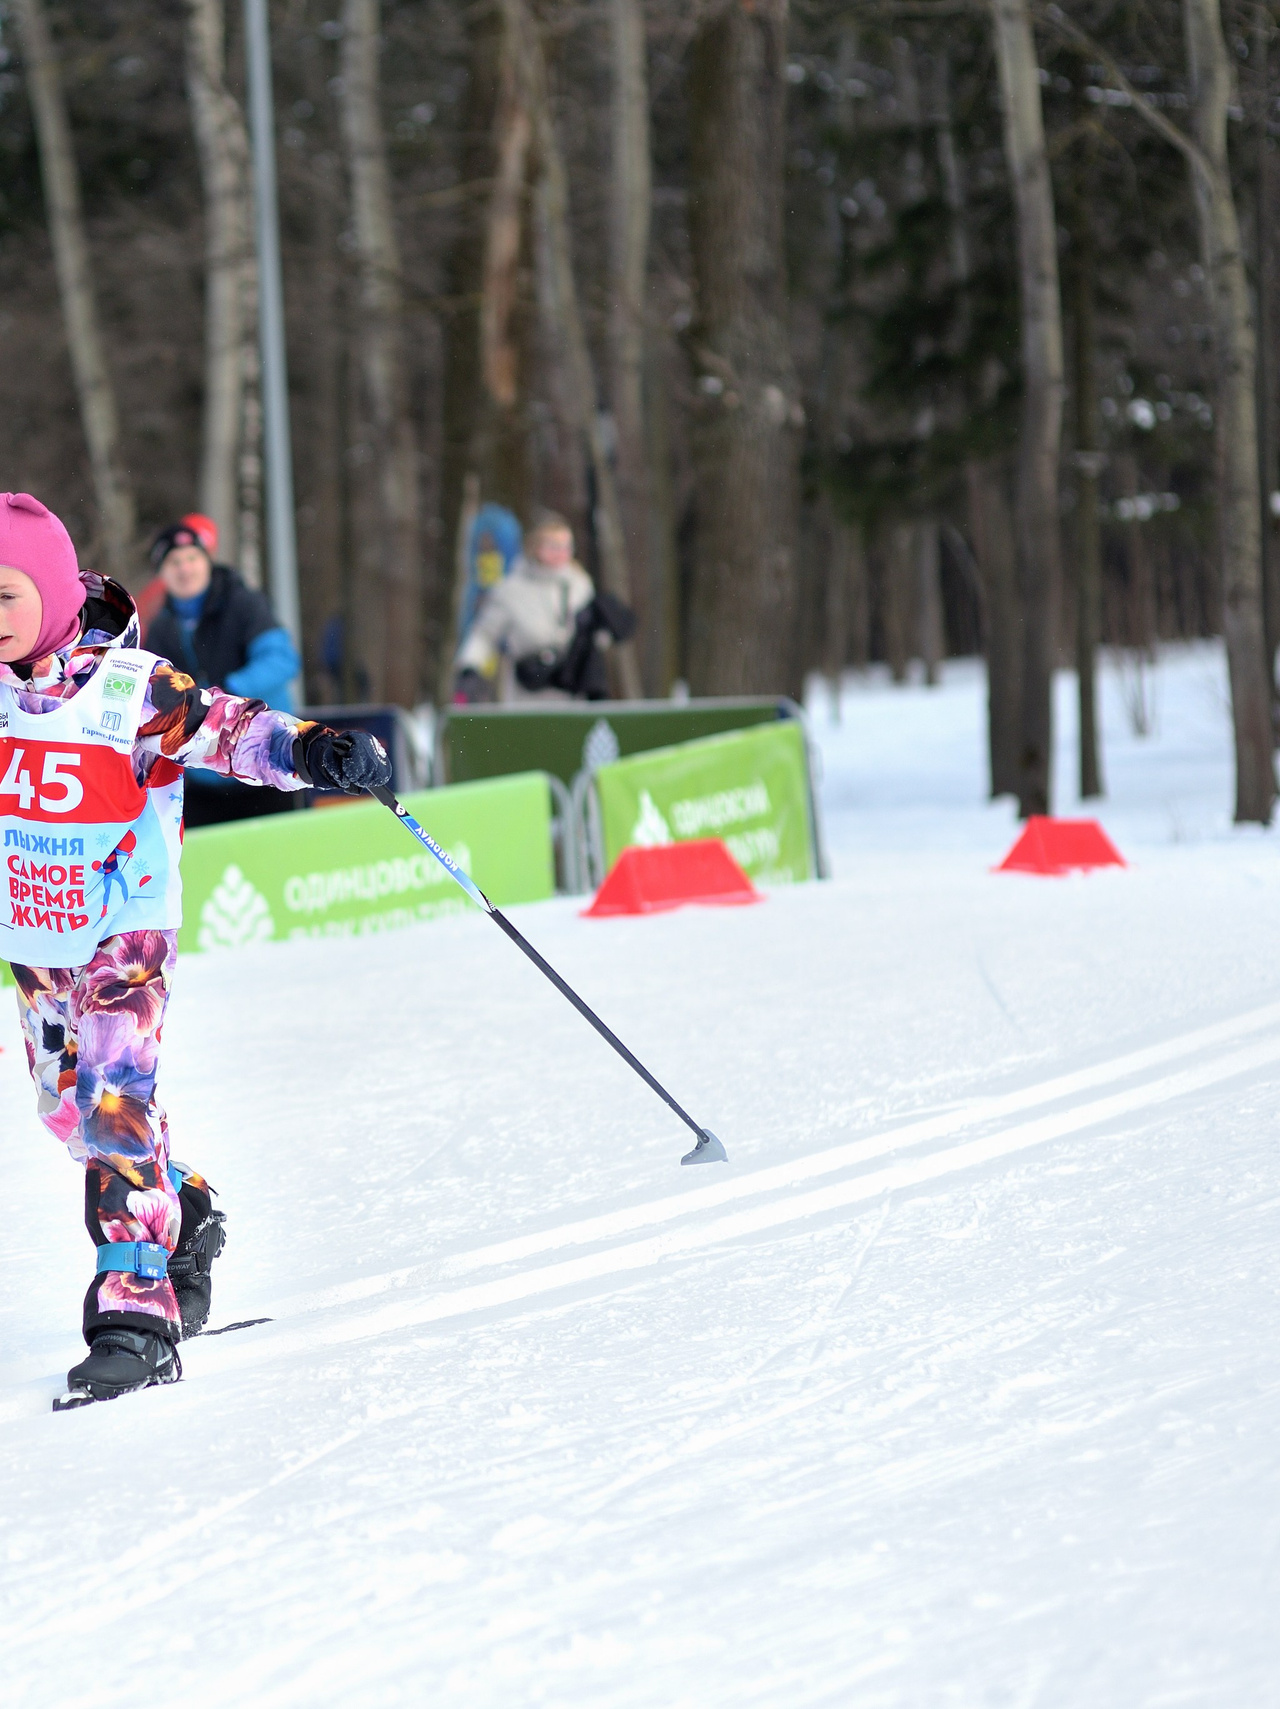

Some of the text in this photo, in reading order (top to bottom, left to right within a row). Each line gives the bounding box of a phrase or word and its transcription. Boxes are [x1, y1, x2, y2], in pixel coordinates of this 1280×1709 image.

[4, 829, 84, 856] ЛЫЖНЯ
[415, 826, 459, 872] NORDWAY
[7, 854, 85, 886] САМОЕ
[9, 877, 85, 909] ВРЕМЯ
[10, 901, 89, 933] ЖИТЬ
[146, 1267, 159, 1277] 45
